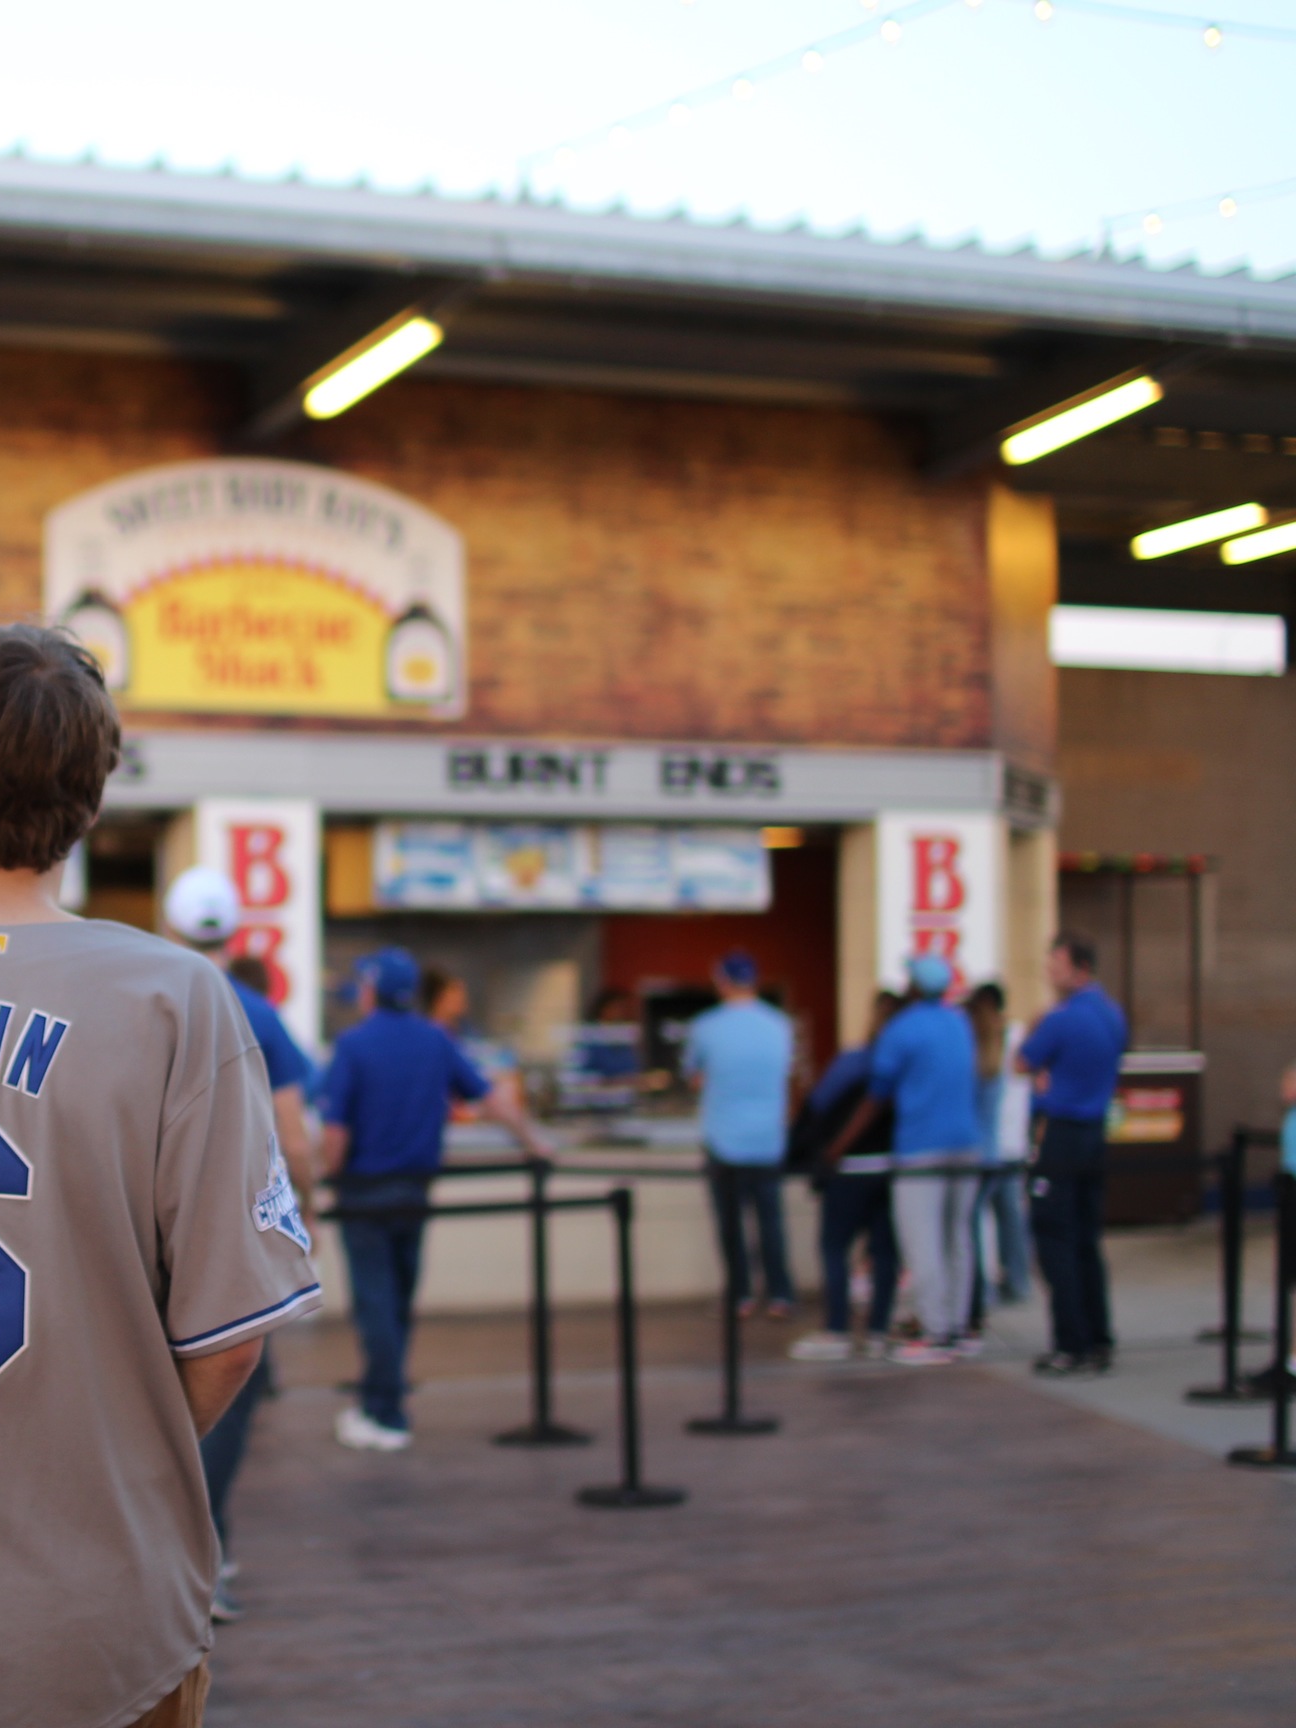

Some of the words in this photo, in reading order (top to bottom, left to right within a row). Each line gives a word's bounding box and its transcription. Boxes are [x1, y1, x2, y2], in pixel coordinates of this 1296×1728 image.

[447, 749, 611, 791] BURNT
[660, 753, 781, 798] ENDS
[226, 822, 293, 1009] BB
